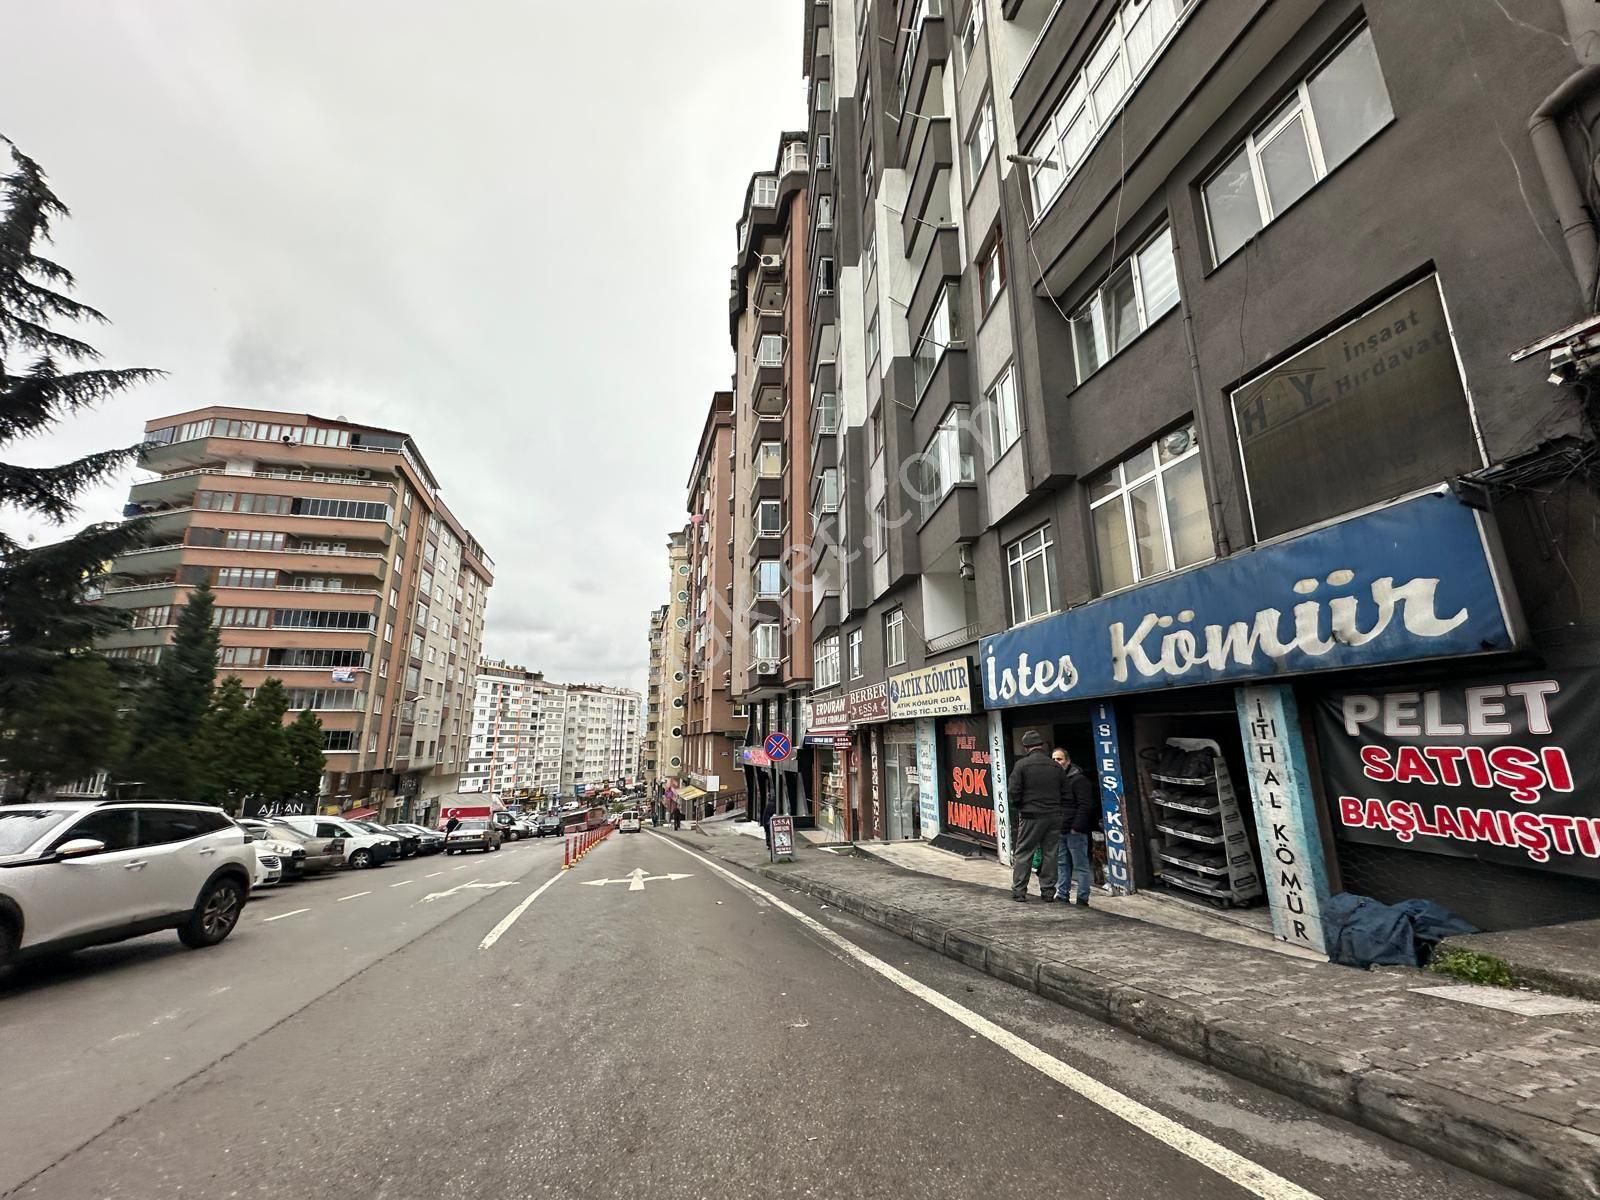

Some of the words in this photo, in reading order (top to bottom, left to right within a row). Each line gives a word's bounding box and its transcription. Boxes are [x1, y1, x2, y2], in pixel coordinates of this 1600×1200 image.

[1342, 307, 1420, 362] İnşaat
[1335, 329, 1446, 395] Hırdavat
[986, 644, 1079, 701] İstes
[1109, 569, 1469, 683] Kömür
[850, 683, 887, 704] BERBER
[924, 661, 968, 695] KÖMÜR
[940, 695, 962, 704] GIDA
[858, 702, 879, 715] ESSA
[934, 706, 950, 714] LTD.
[1342, 679, 1560, 737] PELET
[952, 766, 989, 799] ŞOK
[1360, 744, 1575, 804] SATIŞI
[947, 800, 998, 838] KAMPANYA
[997, 790, 1008, 853] KÖMÜR
[1252, 698, 1282, 809] İTHAL
[1273, 823, 1309, 941] KÖMÜR
